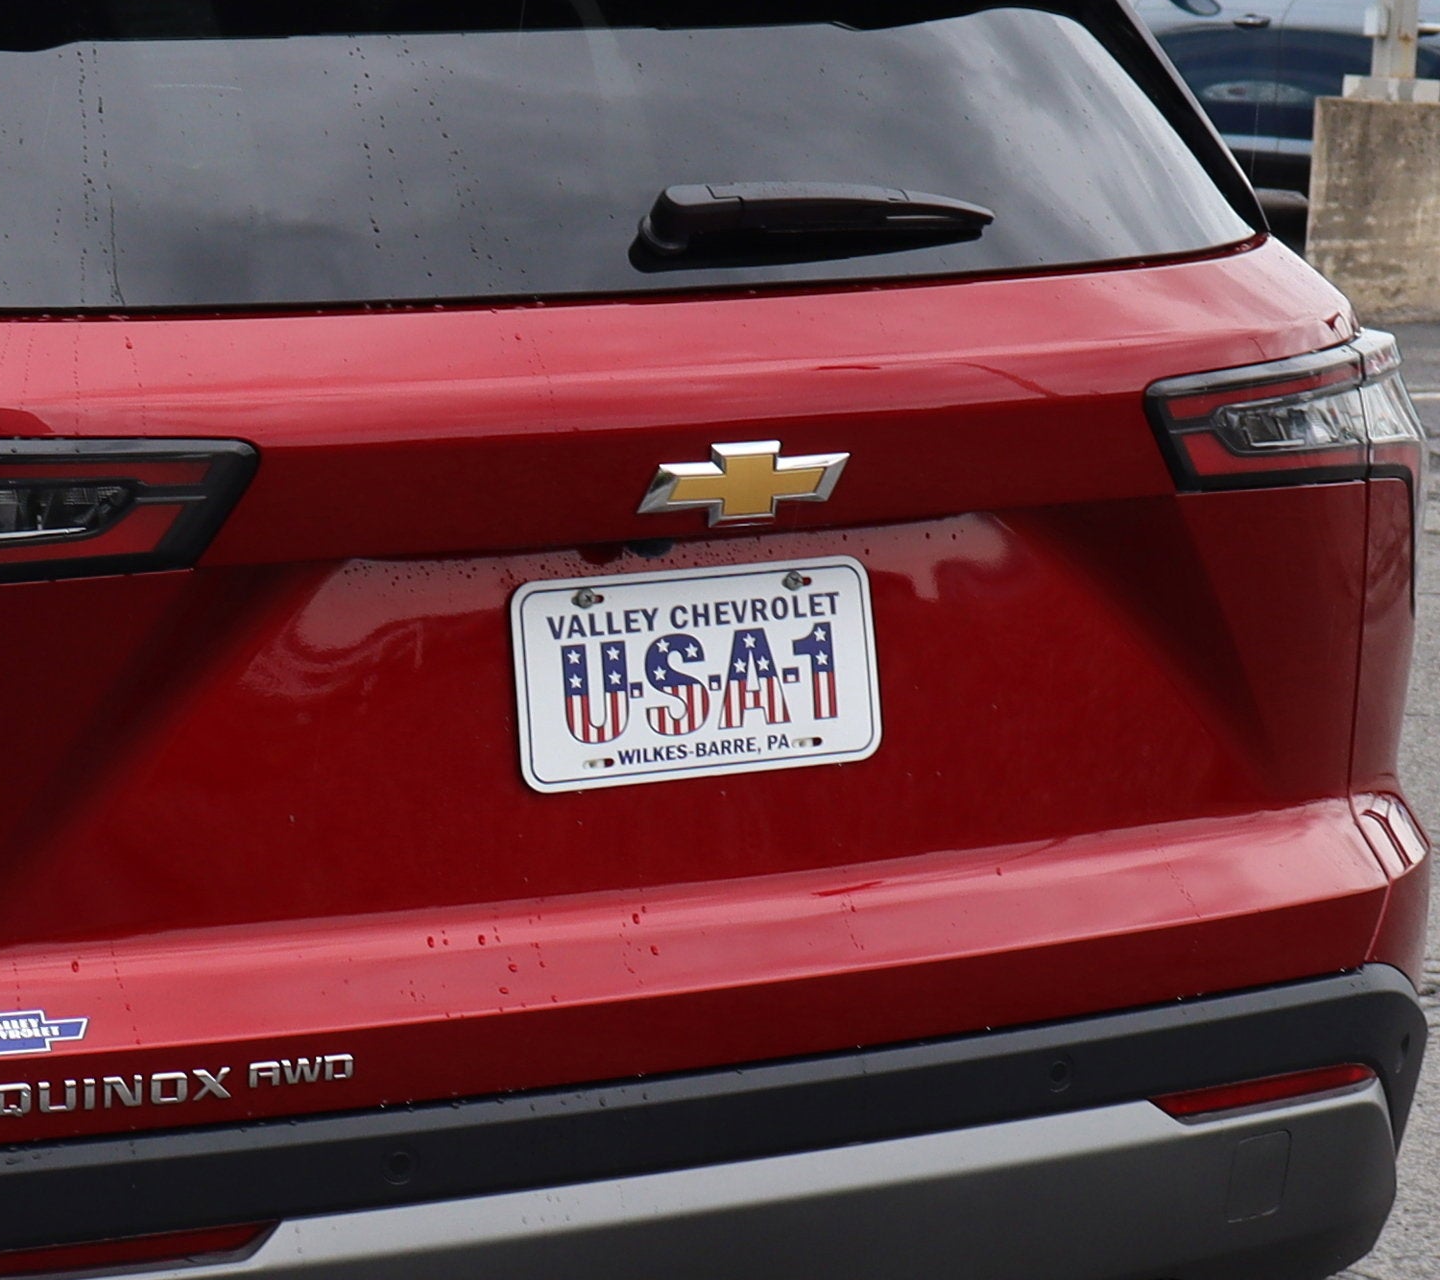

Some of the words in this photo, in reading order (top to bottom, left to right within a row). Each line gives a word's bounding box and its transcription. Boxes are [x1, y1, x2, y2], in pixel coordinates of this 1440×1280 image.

[546, 607, 659, 640] VALLEY
[669, 591, 840, 629] CHEVROLET
[617, 738, 762, 765] WILKES-BARRE,
[767, 734, 790, 751] PA
[248, 1053, 354, 1088] AWD
